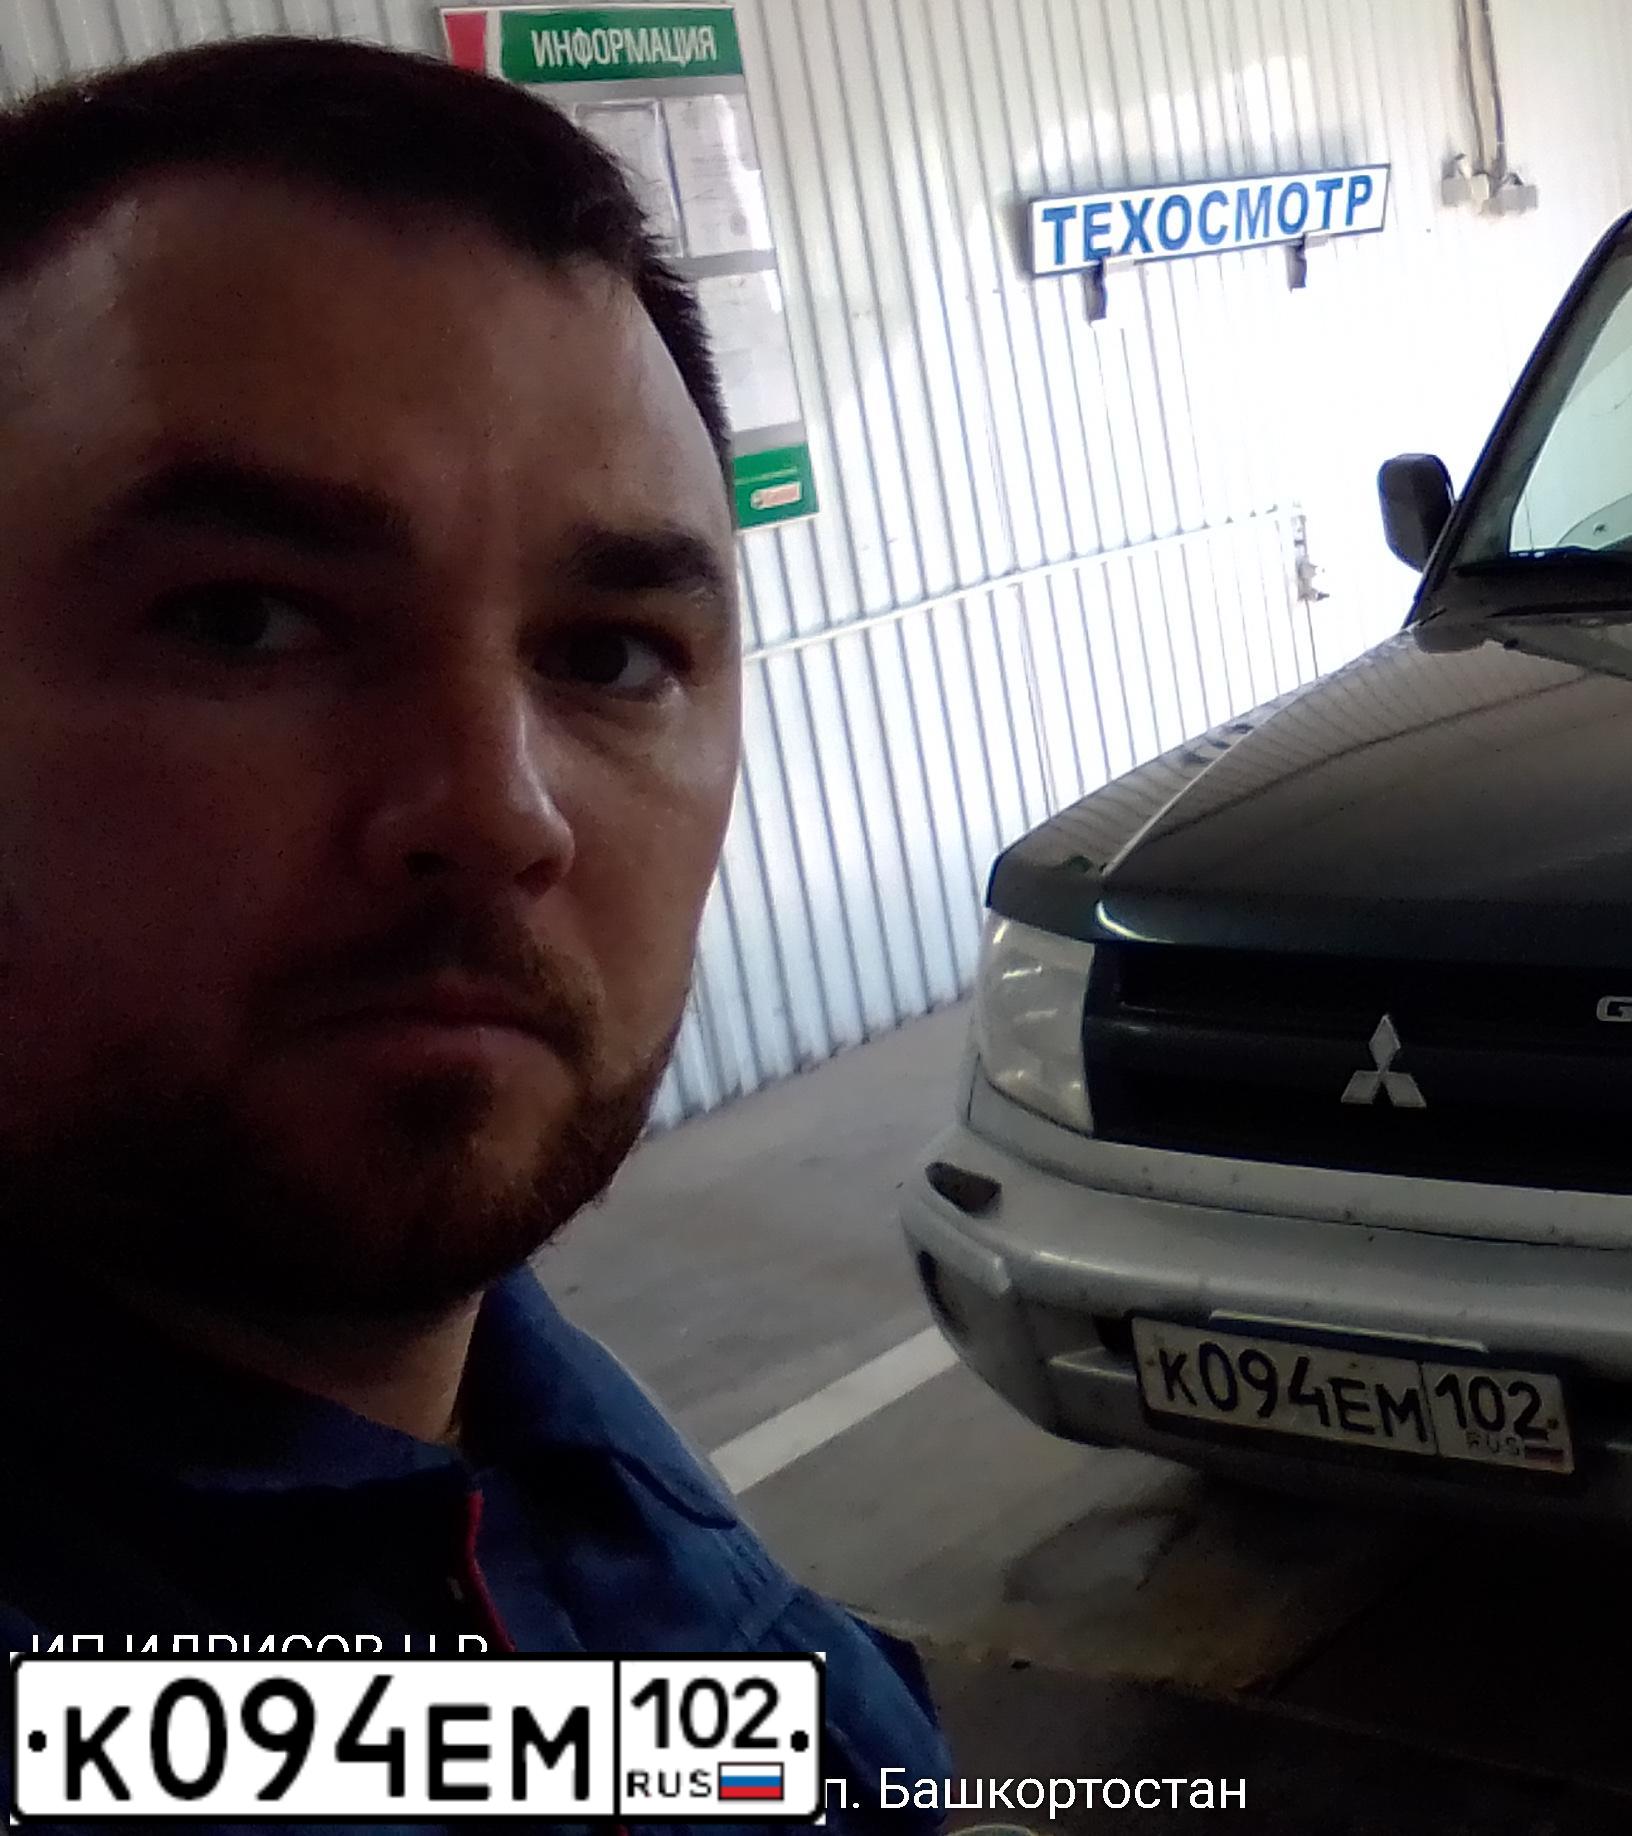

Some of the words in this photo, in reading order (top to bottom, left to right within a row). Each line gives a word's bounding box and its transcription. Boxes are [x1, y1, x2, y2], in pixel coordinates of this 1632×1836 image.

[531, 25, 718, 69] ИНФОРМАЦИЯ
[1042, 174, 1374, 265] ТЕХОСМОТР
[1434, 1373, 1549, 1442] 102
